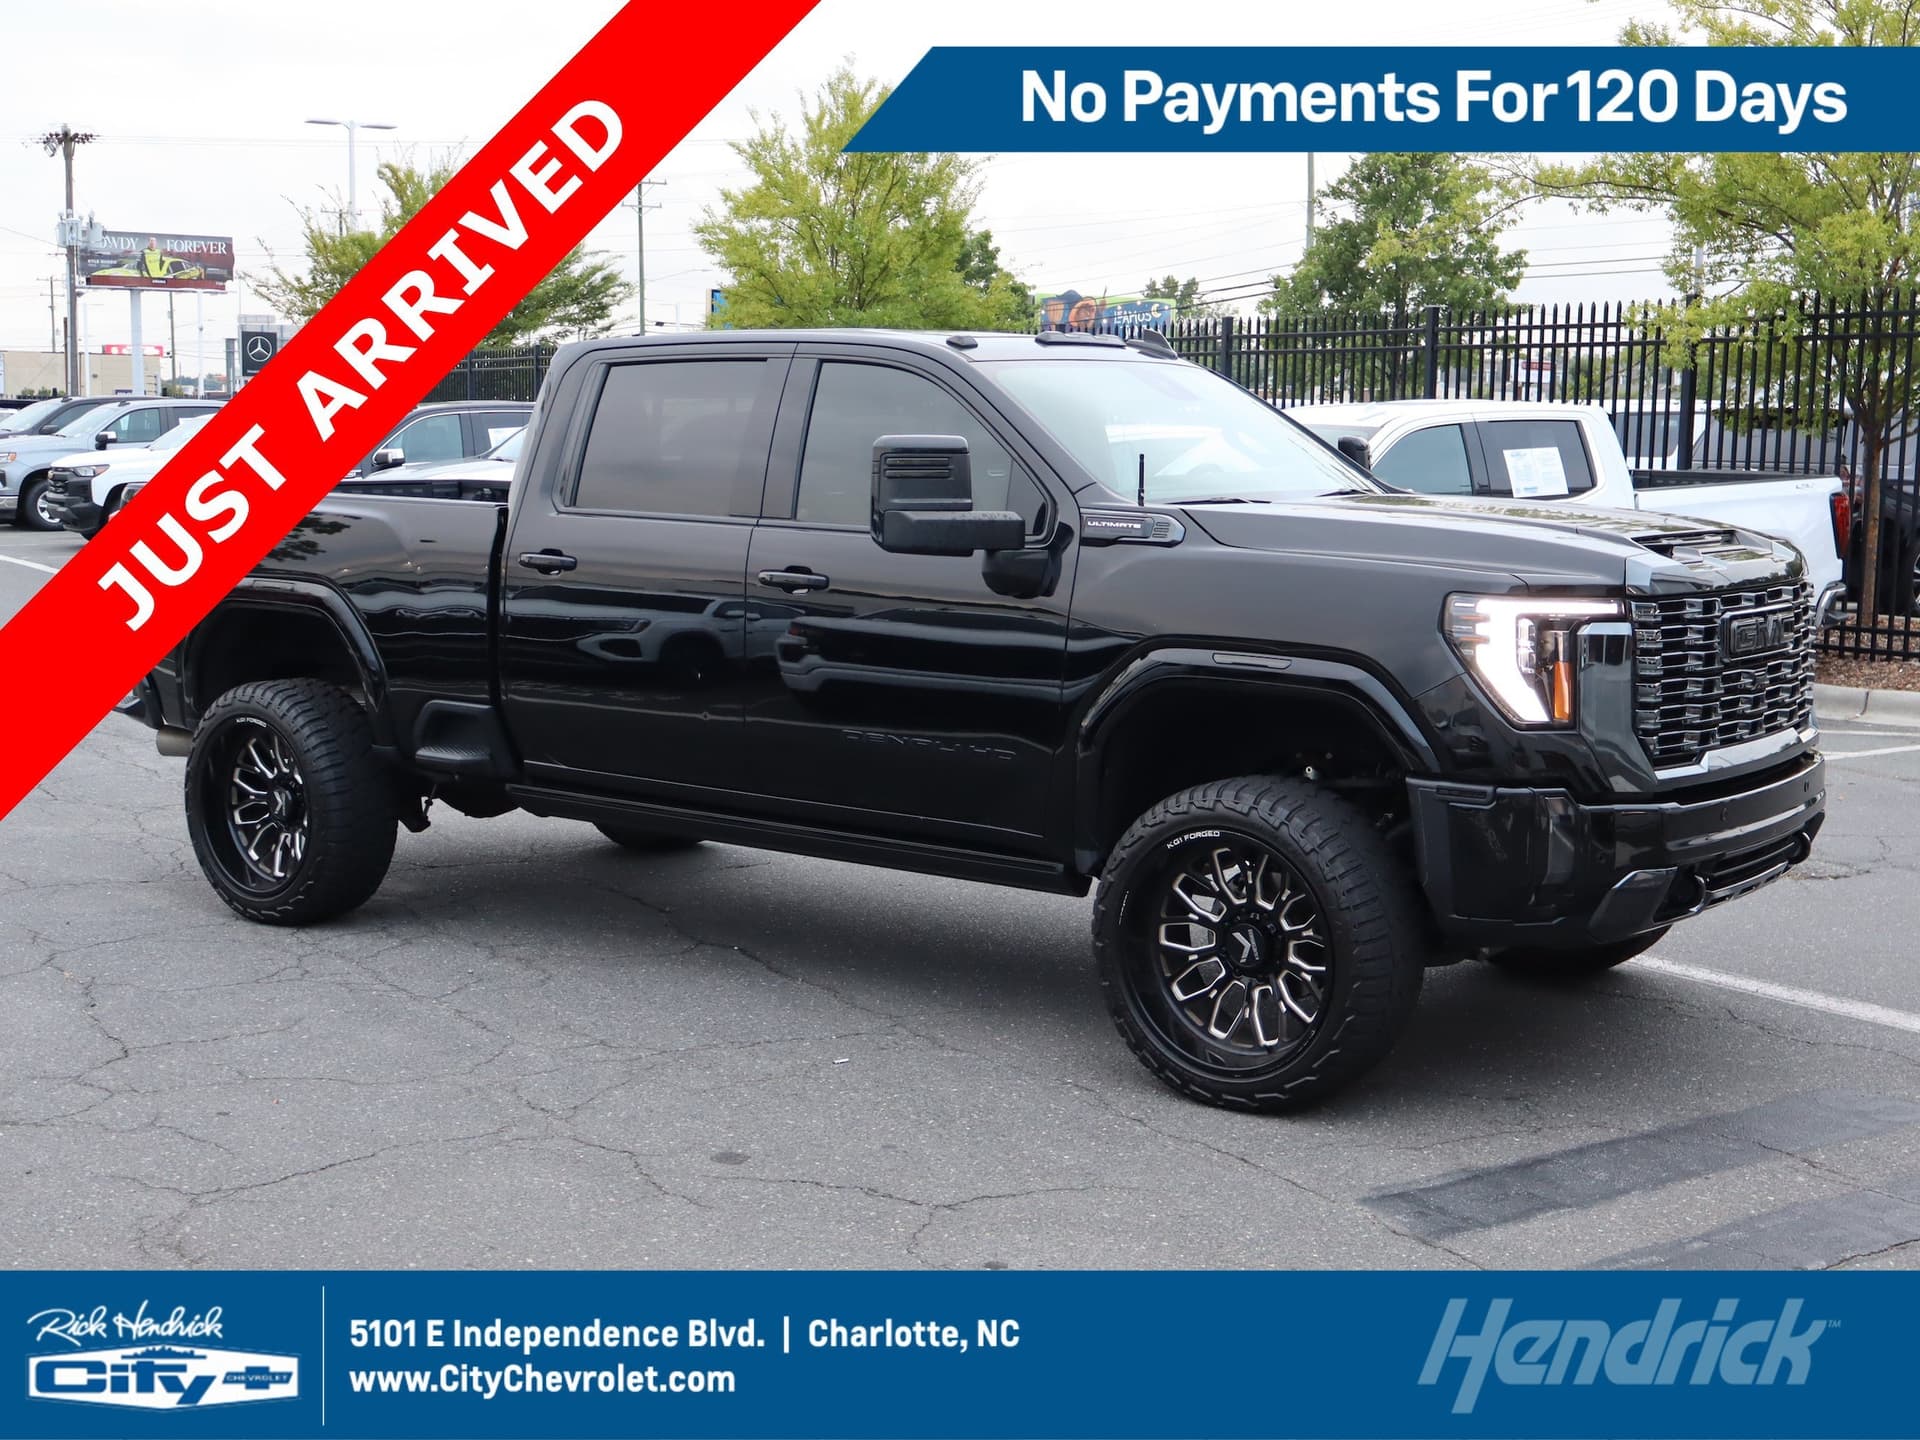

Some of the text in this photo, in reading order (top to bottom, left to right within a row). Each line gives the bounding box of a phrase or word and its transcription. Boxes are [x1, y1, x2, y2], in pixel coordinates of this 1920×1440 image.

[102, 235, 227, 255] WDY FOREVER
[1087, 520, 1142, 529] ULTIMATE
[1730, 612, 1796, 653] GMC
[1183, 830, 1220, 841] FORGED
